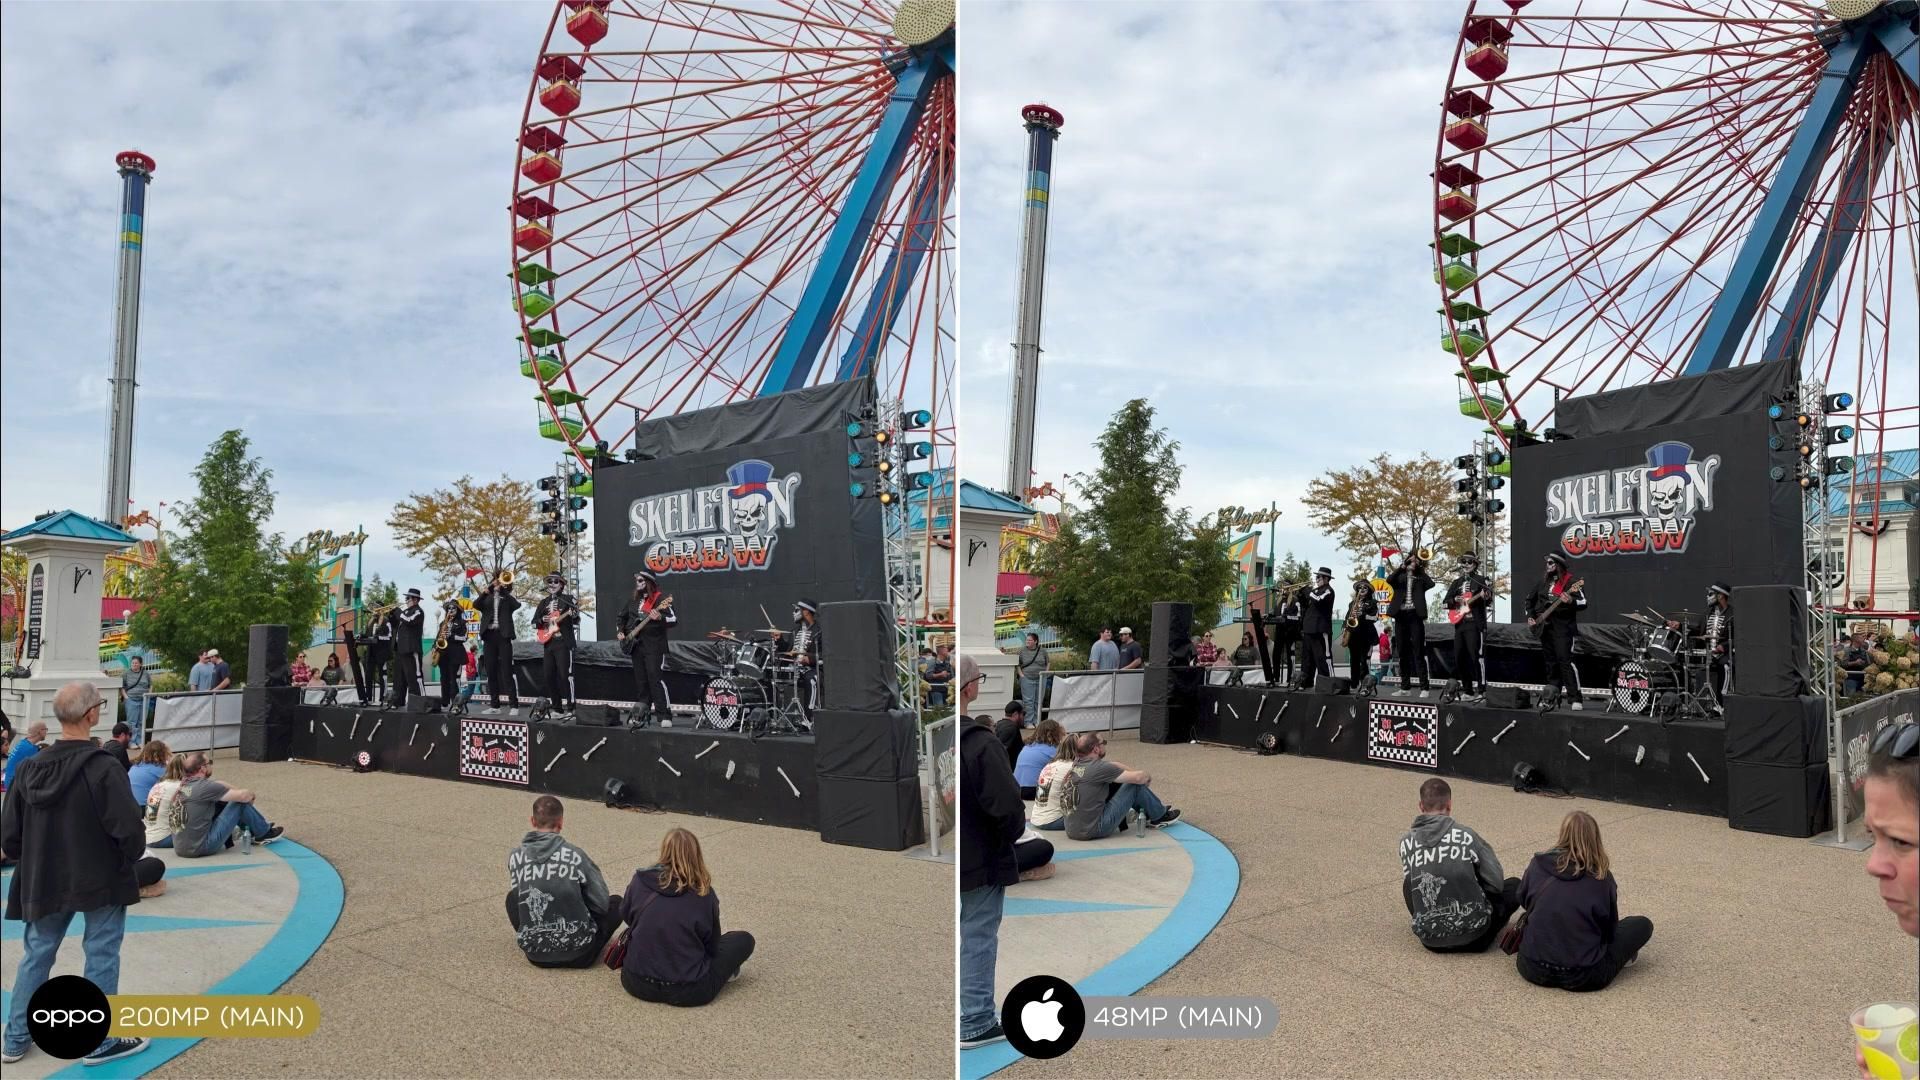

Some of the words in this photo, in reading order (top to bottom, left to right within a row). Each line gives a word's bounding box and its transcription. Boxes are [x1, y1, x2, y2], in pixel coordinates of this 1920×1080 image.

[631, 476, 800, 543] SKELETON
[1548, 458, 1718, 525] SKELETON
[645, 534, 774, 574] CREW
[1563, 517, 1692, 554] CREW
